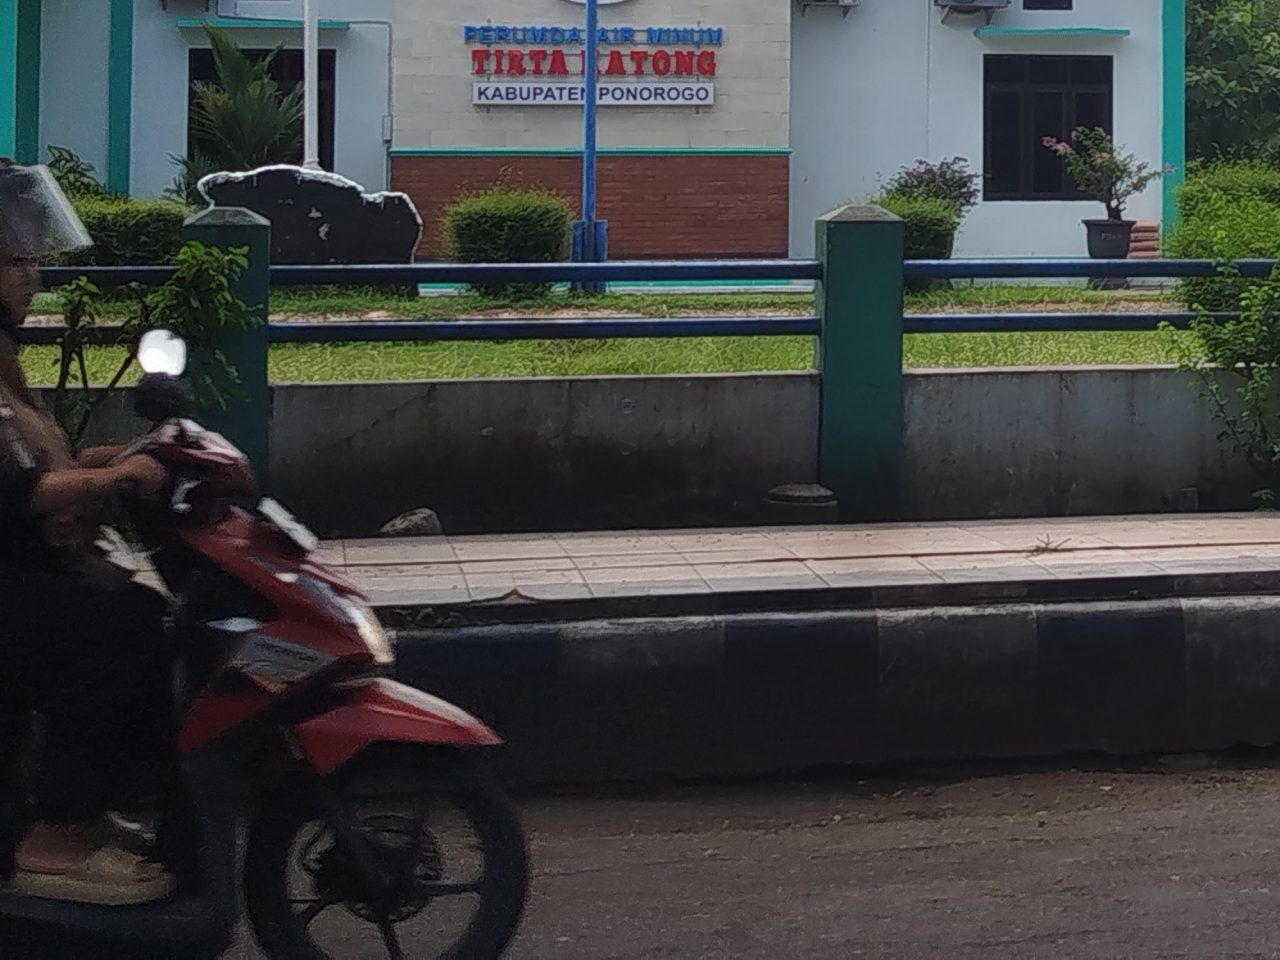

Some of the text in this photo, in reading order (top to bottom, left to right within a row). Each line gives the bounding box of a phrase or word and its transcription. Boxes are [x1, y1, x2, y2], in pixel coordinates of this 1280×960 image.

[463, 26, 723, 46] PERUMDA AIR MINUM
[470, 49, 717, 77] TIRTA ATONG
[598, 87, 710, 102] PONOROGO
